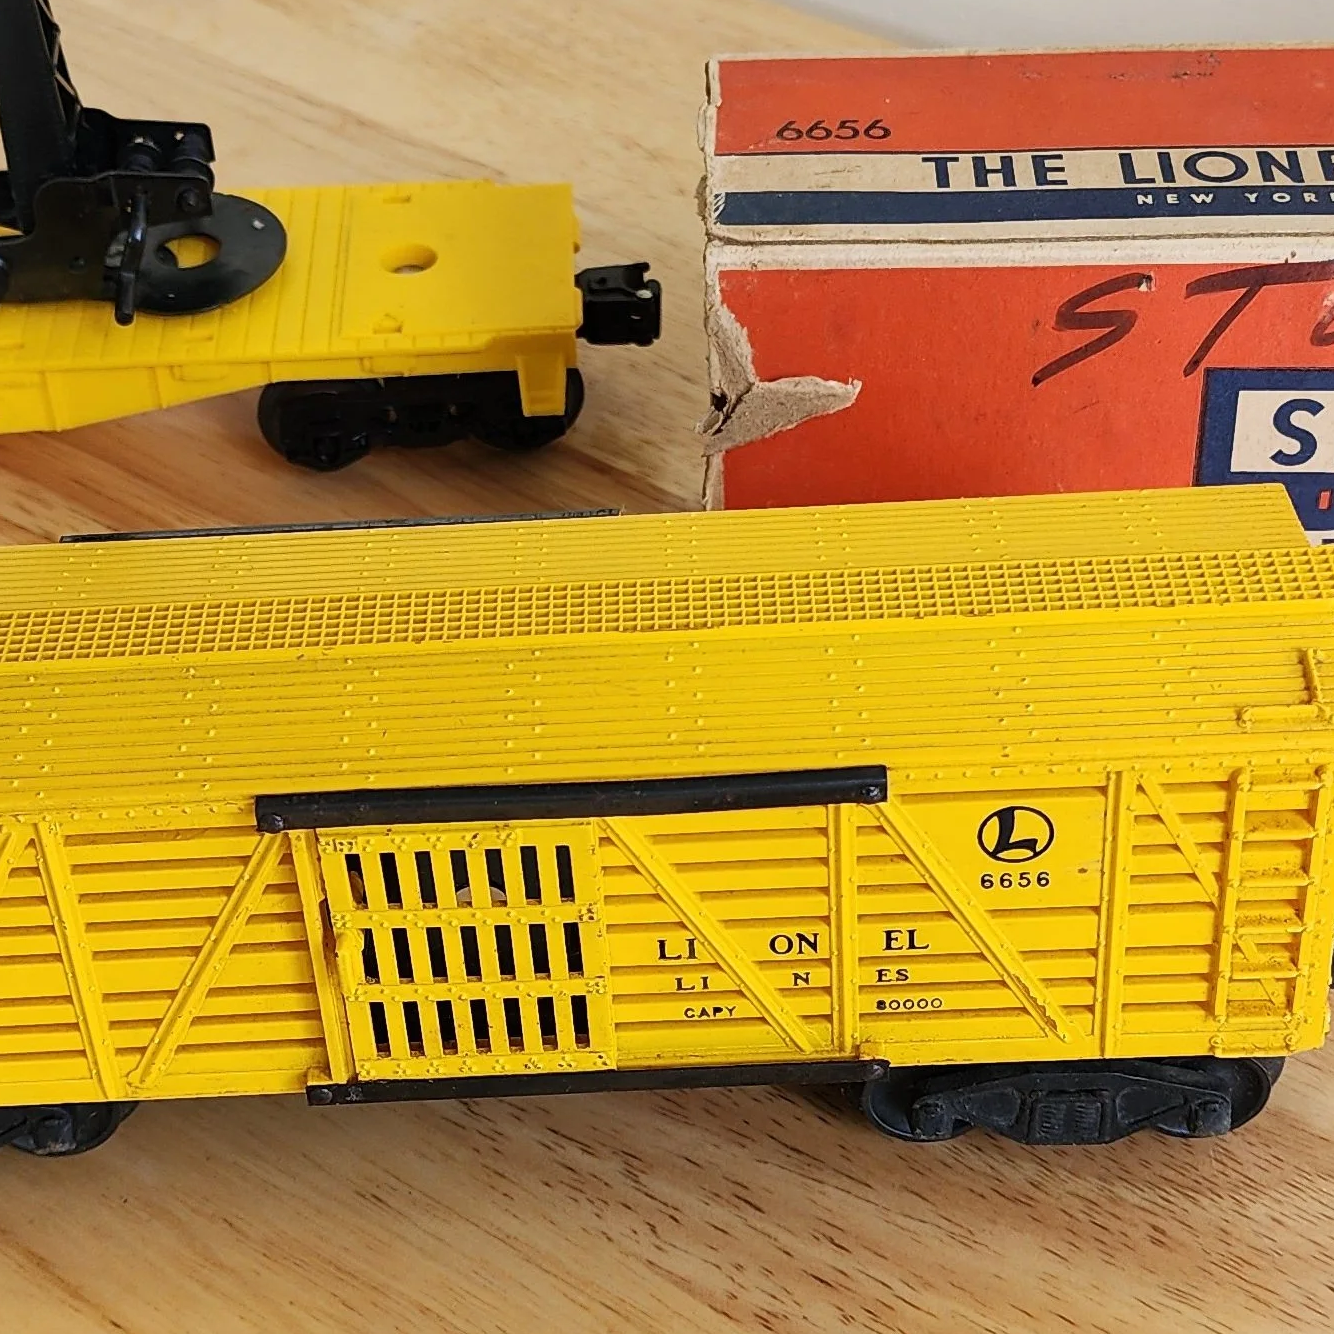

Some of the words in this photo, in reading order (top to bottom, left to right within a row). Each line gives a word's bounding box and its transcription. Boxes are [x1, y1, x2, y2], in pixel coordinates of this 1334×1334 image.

[776, 119, 893, 143] 6656
[922, 154, 1069, 189] THE
[1136, 192, 1214, 206] NEW
[980, 871, 1050, 889] 6656
[683, 1005, 737, 1019] CAPY
[875, 997, 943, 1011] 80000
